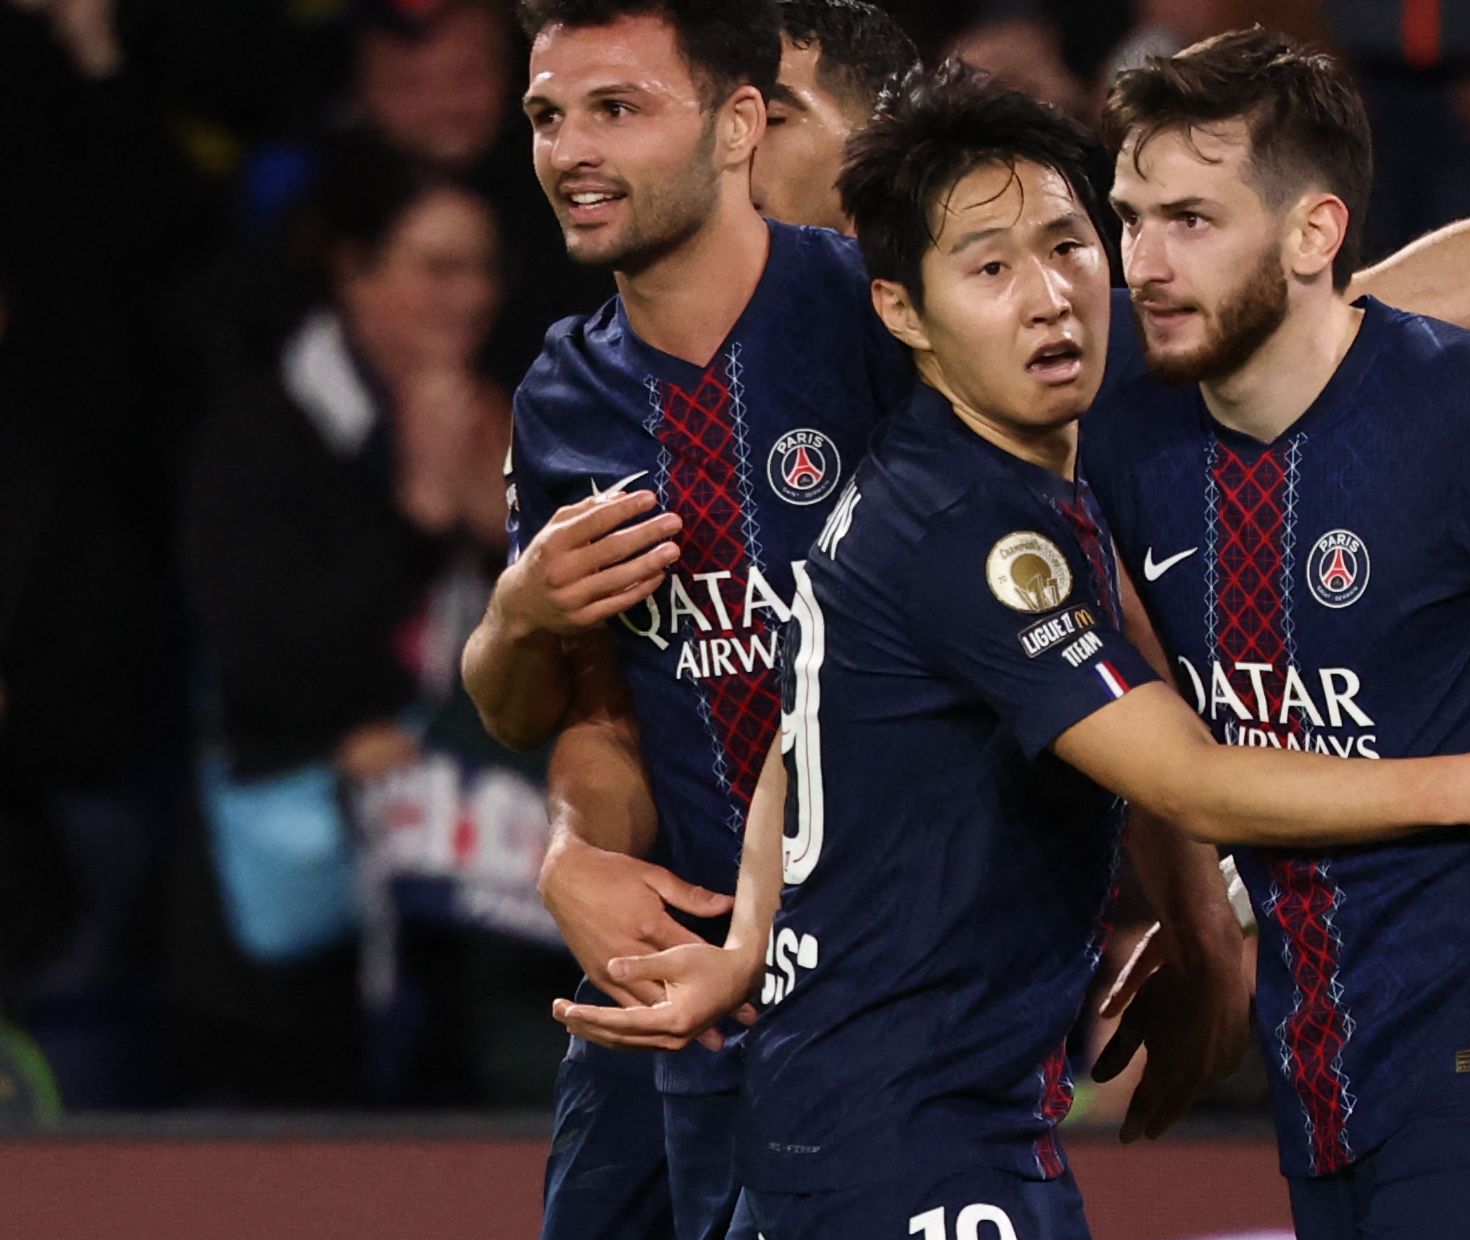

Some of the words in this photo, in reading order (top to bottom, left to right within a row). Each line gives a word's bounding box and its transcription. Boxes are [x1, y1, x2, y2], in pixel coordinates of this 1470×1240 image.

[777, 433, 824, 454] PARIS
[1319, 534, 1360, 552] PARIS
[676, 630, 778, 680] AIRW
